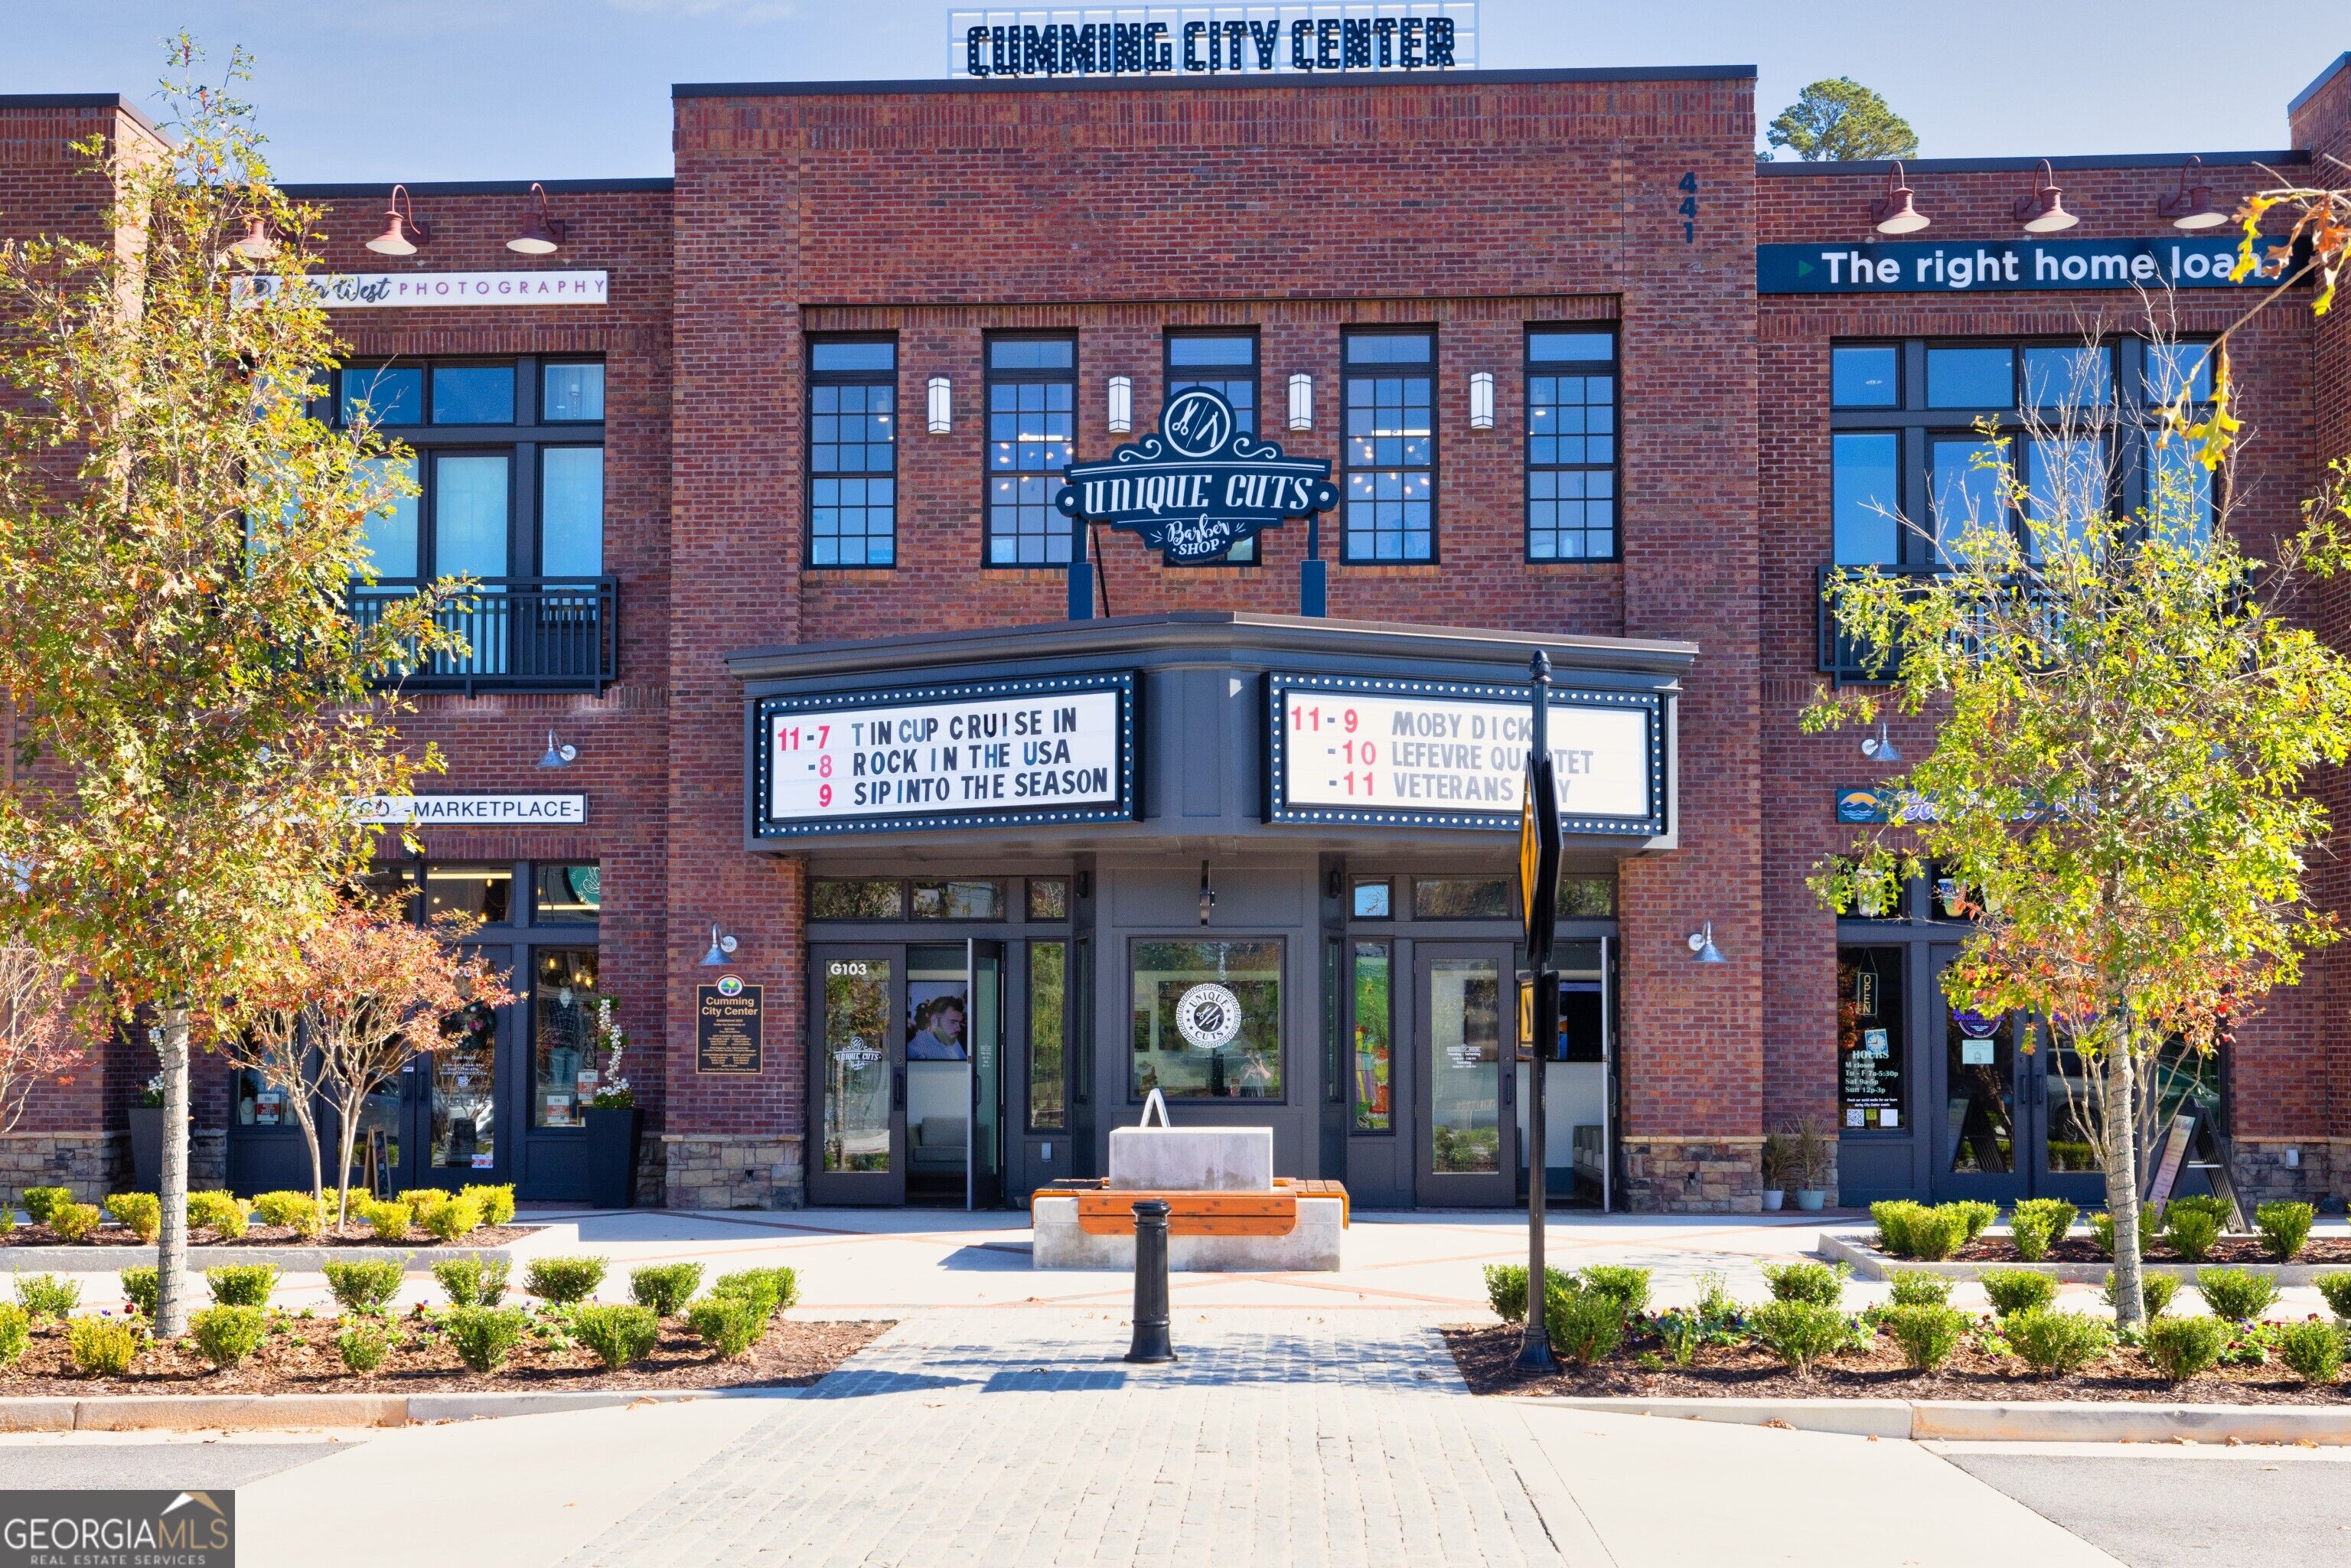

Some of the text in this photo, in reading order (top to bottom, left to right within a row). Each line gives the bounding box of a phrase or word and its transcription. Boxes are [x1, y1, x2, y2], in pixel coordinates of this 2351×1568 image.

[967, 18, 1455, 76] CUMMING CITY CENTER
[1678, 171, 1697, 244] 441
[1821, 252, 1900, 284] The
[1916, 250, 2020, 289] right
[2036, 248, 2156, 282] home
[399, 279, 605, 295] PHOTOGRAPHY
[1083, 474, 1314, 515] UNIQUE CUTS
[1165, 513, 1231, 546] Barber
[1178, 540, 1218, 556] SHOP
[851, 719, 892, 747] TIN
[898, 717, 939, 744] CUP
[950, 709, 1042, 739] CRUISE
[1054, 706, 1077, 733] IN
[1391, 710, 1463, 738] MOBY
[1472, 714, 1533, 742] DICK
[853, 748, 918, 777] ROCK
[931, 746, 958, 772] IN
[969, 743, 1011, 770] THE
[1024, 738, 1071, 767] USA
[1392, 741, 1482, 771] LEFEVRE
[1490, 746, 1594, 774] QUTET
[819, 783, 833, 808] 9
[961, 773, 1005, 800] THE
[1015, 767, 1108, 798] SEASON
[1394, 771, 1514, 802] VETERANS
[830, 963, 867, 976] G103
[702, 1006, 758, 1017] City Center
[706, 996, 755, 1007] Cumming
[1189, 991, 1229, 1008] UNIQUE
[1195, 1030, 1224, 1041] CUTS
[862, 1052, 879, 1061] CUTS
[1853, 1050, 1890, 1059] HOURS
[1868, 1070, 1899, 1078] 7a-5:30p
